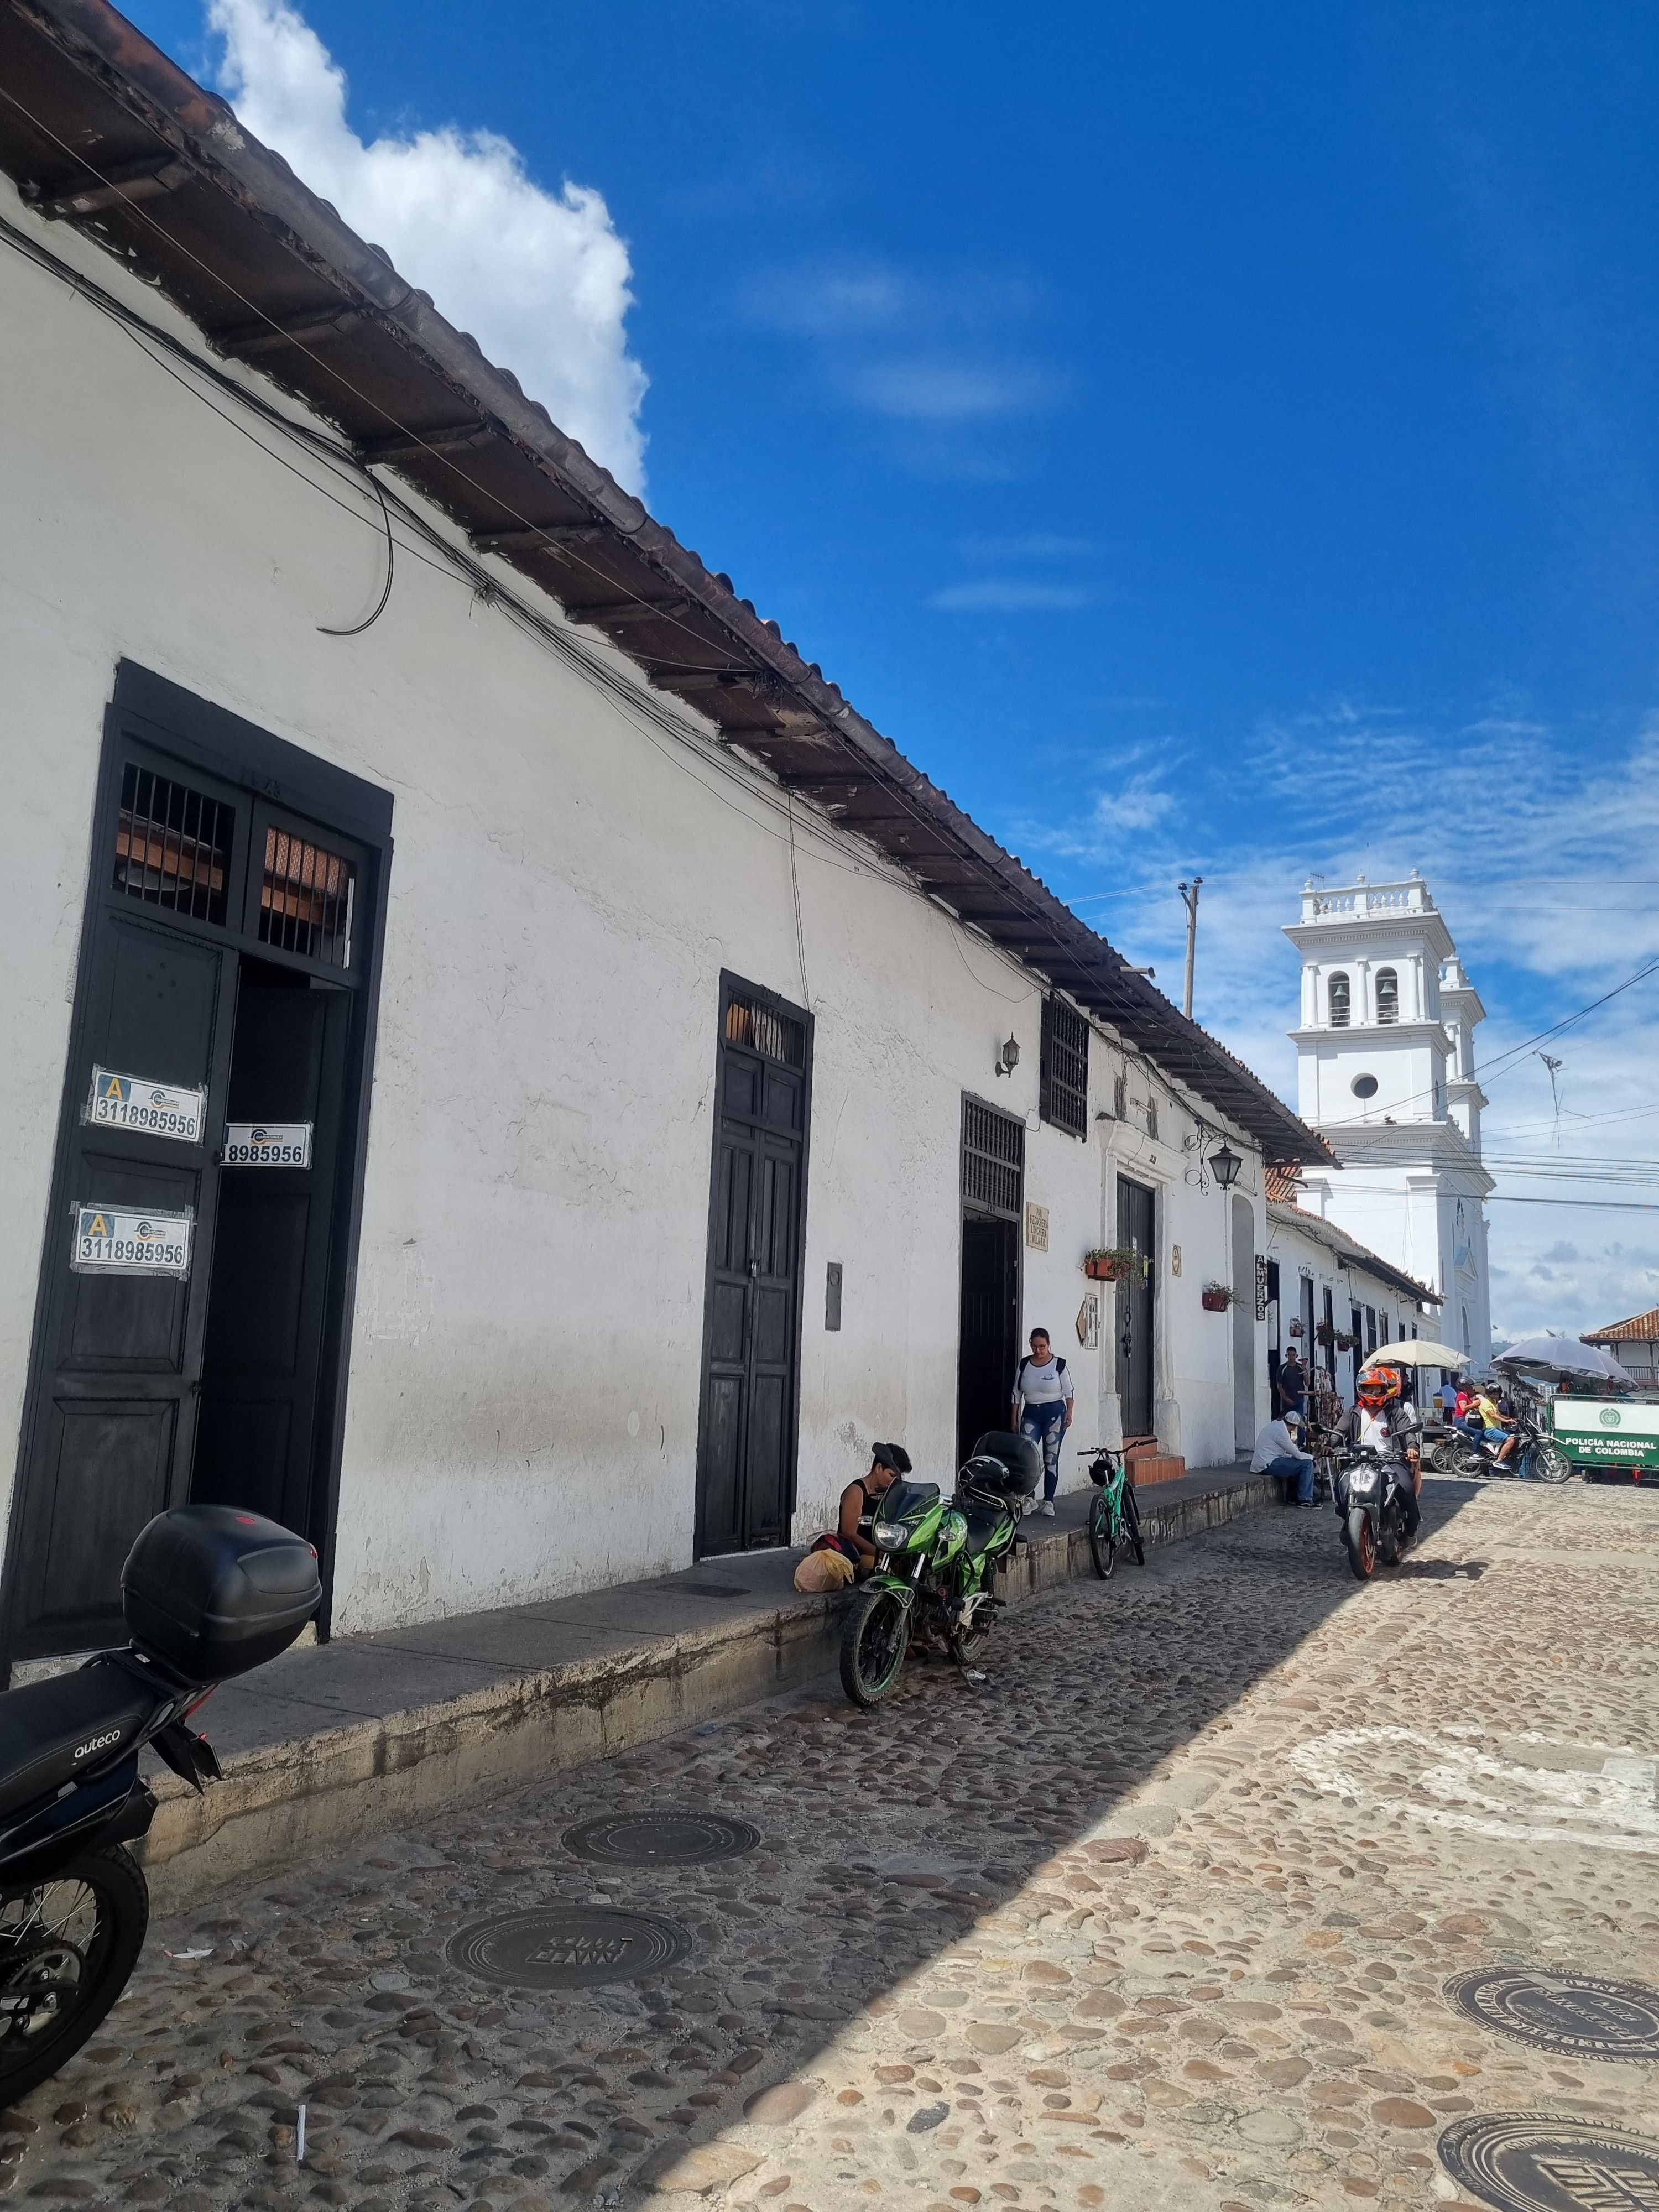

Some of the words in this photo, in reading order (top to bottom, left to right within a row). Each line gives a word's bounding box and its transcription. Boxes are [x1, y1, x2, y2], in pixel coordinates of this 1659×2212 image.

[104, 1077, 123, 1101] A
[98, 1099, 196, 1136] 3118985956
[228, 1145, 302, 1163] 8985956
[88, 1214, 107, 1237] A
[81, 1237, 183, 1265] 3118985956
[1256, 1256, 1265, 1320] ALMUERZOS
[1566, 1438, 1604, 1447] POLICÍA
[1606, 1439, 1657, 1449] NACIONAL
[1595, 1447, 1645, 1457] COLOMBIA
[74, 1729, 121, 1759] auteco
